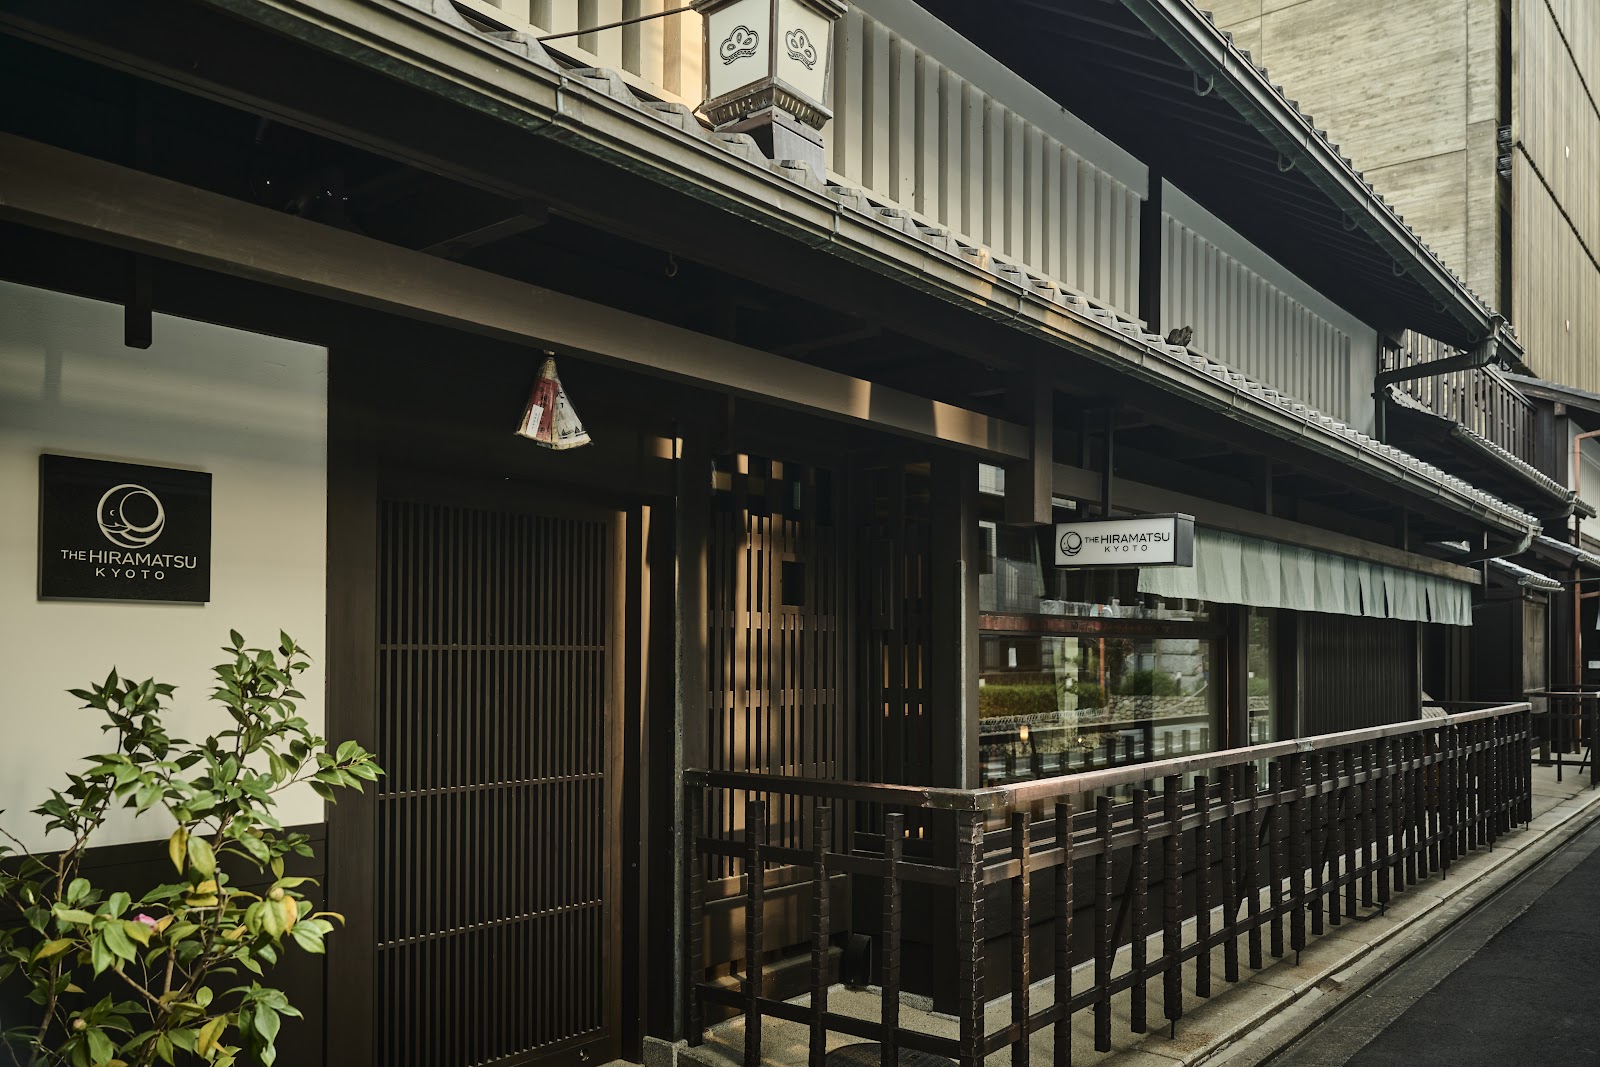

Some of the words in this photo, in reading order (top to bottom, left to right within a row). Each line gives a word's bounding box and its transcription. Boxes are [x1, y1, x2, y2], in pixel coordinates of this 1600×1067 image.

[1084, 536, 1099, 544] THE
[1100, 532, 1170, 544] HIRAMATSU
[1104, 544, 1148, 553] KYOTO
[61, 550, 87, 561] THE
[89, 549, 197, 569] HIRAMATSU
[95, 567, 165, 580] KYOTO
